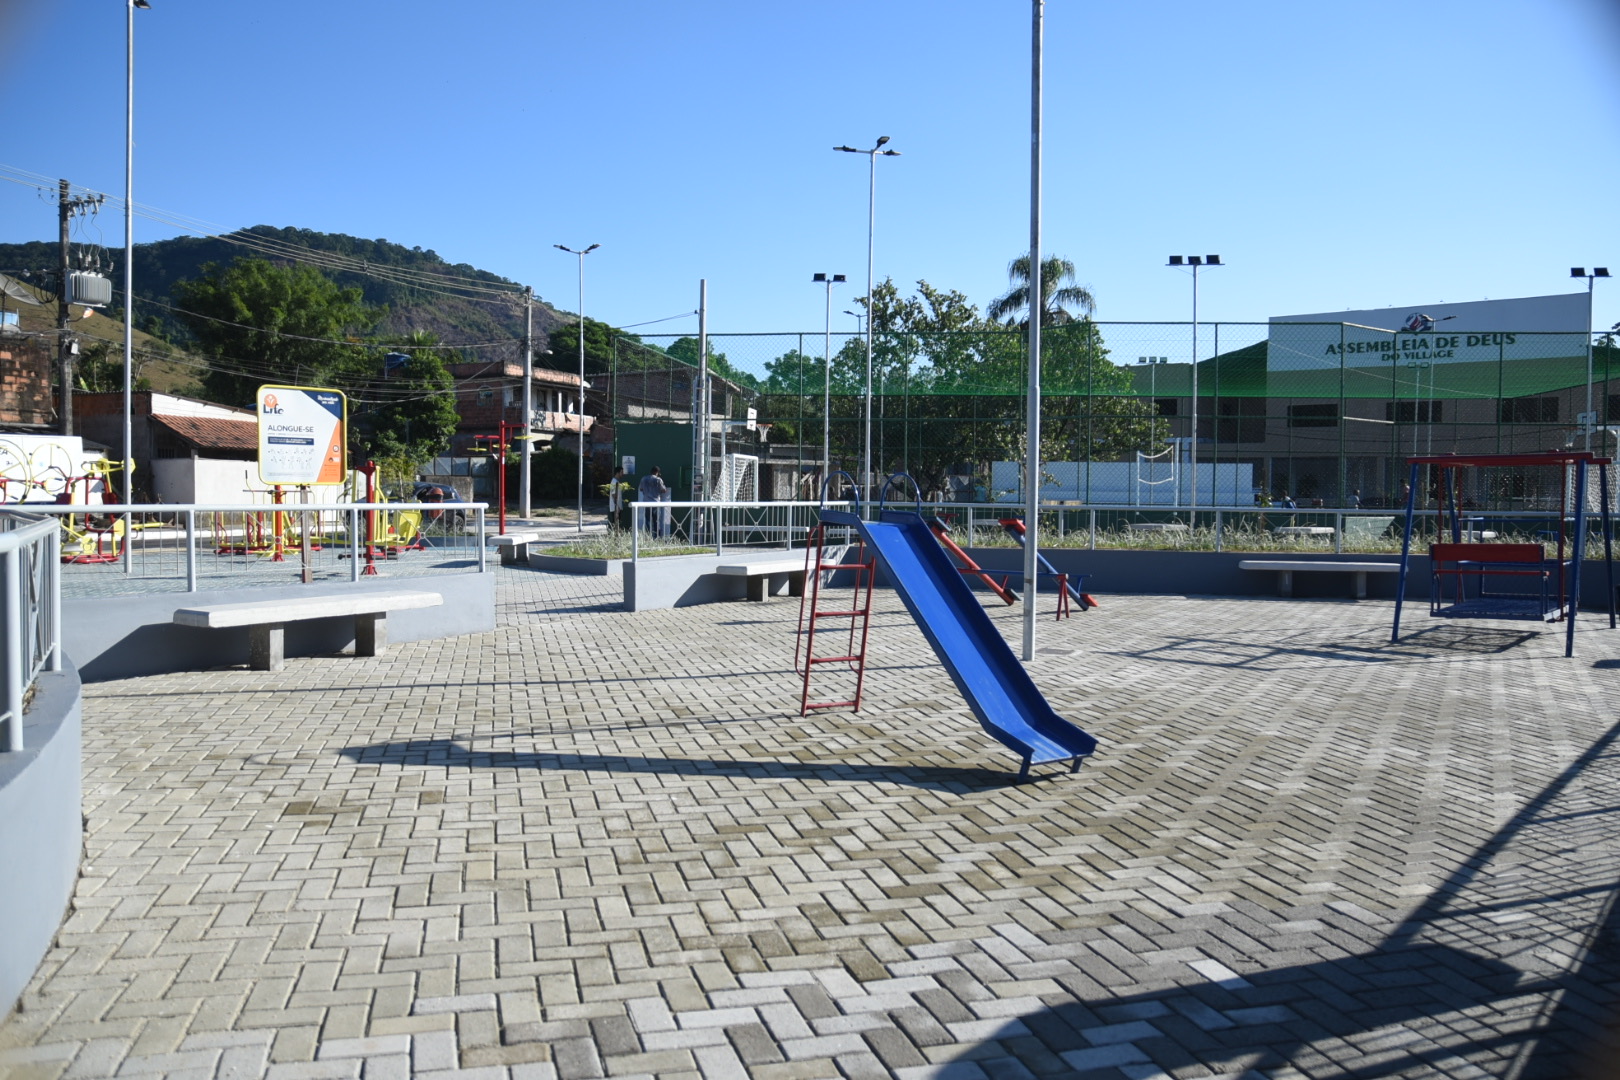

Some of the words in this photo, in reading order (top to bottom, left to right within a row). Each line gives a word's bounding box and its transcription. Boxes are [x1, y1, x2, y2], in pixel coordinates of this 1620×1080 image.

[1325, 338, 1430, 355] ASSEMBLEIA
[1435, 336, 1460, 349] DE
[1466, 333, 1516, 347] DEUS
[1381, 353, 1400, 361] DO
[1403, 349, 1454, 360] VILLAGE
